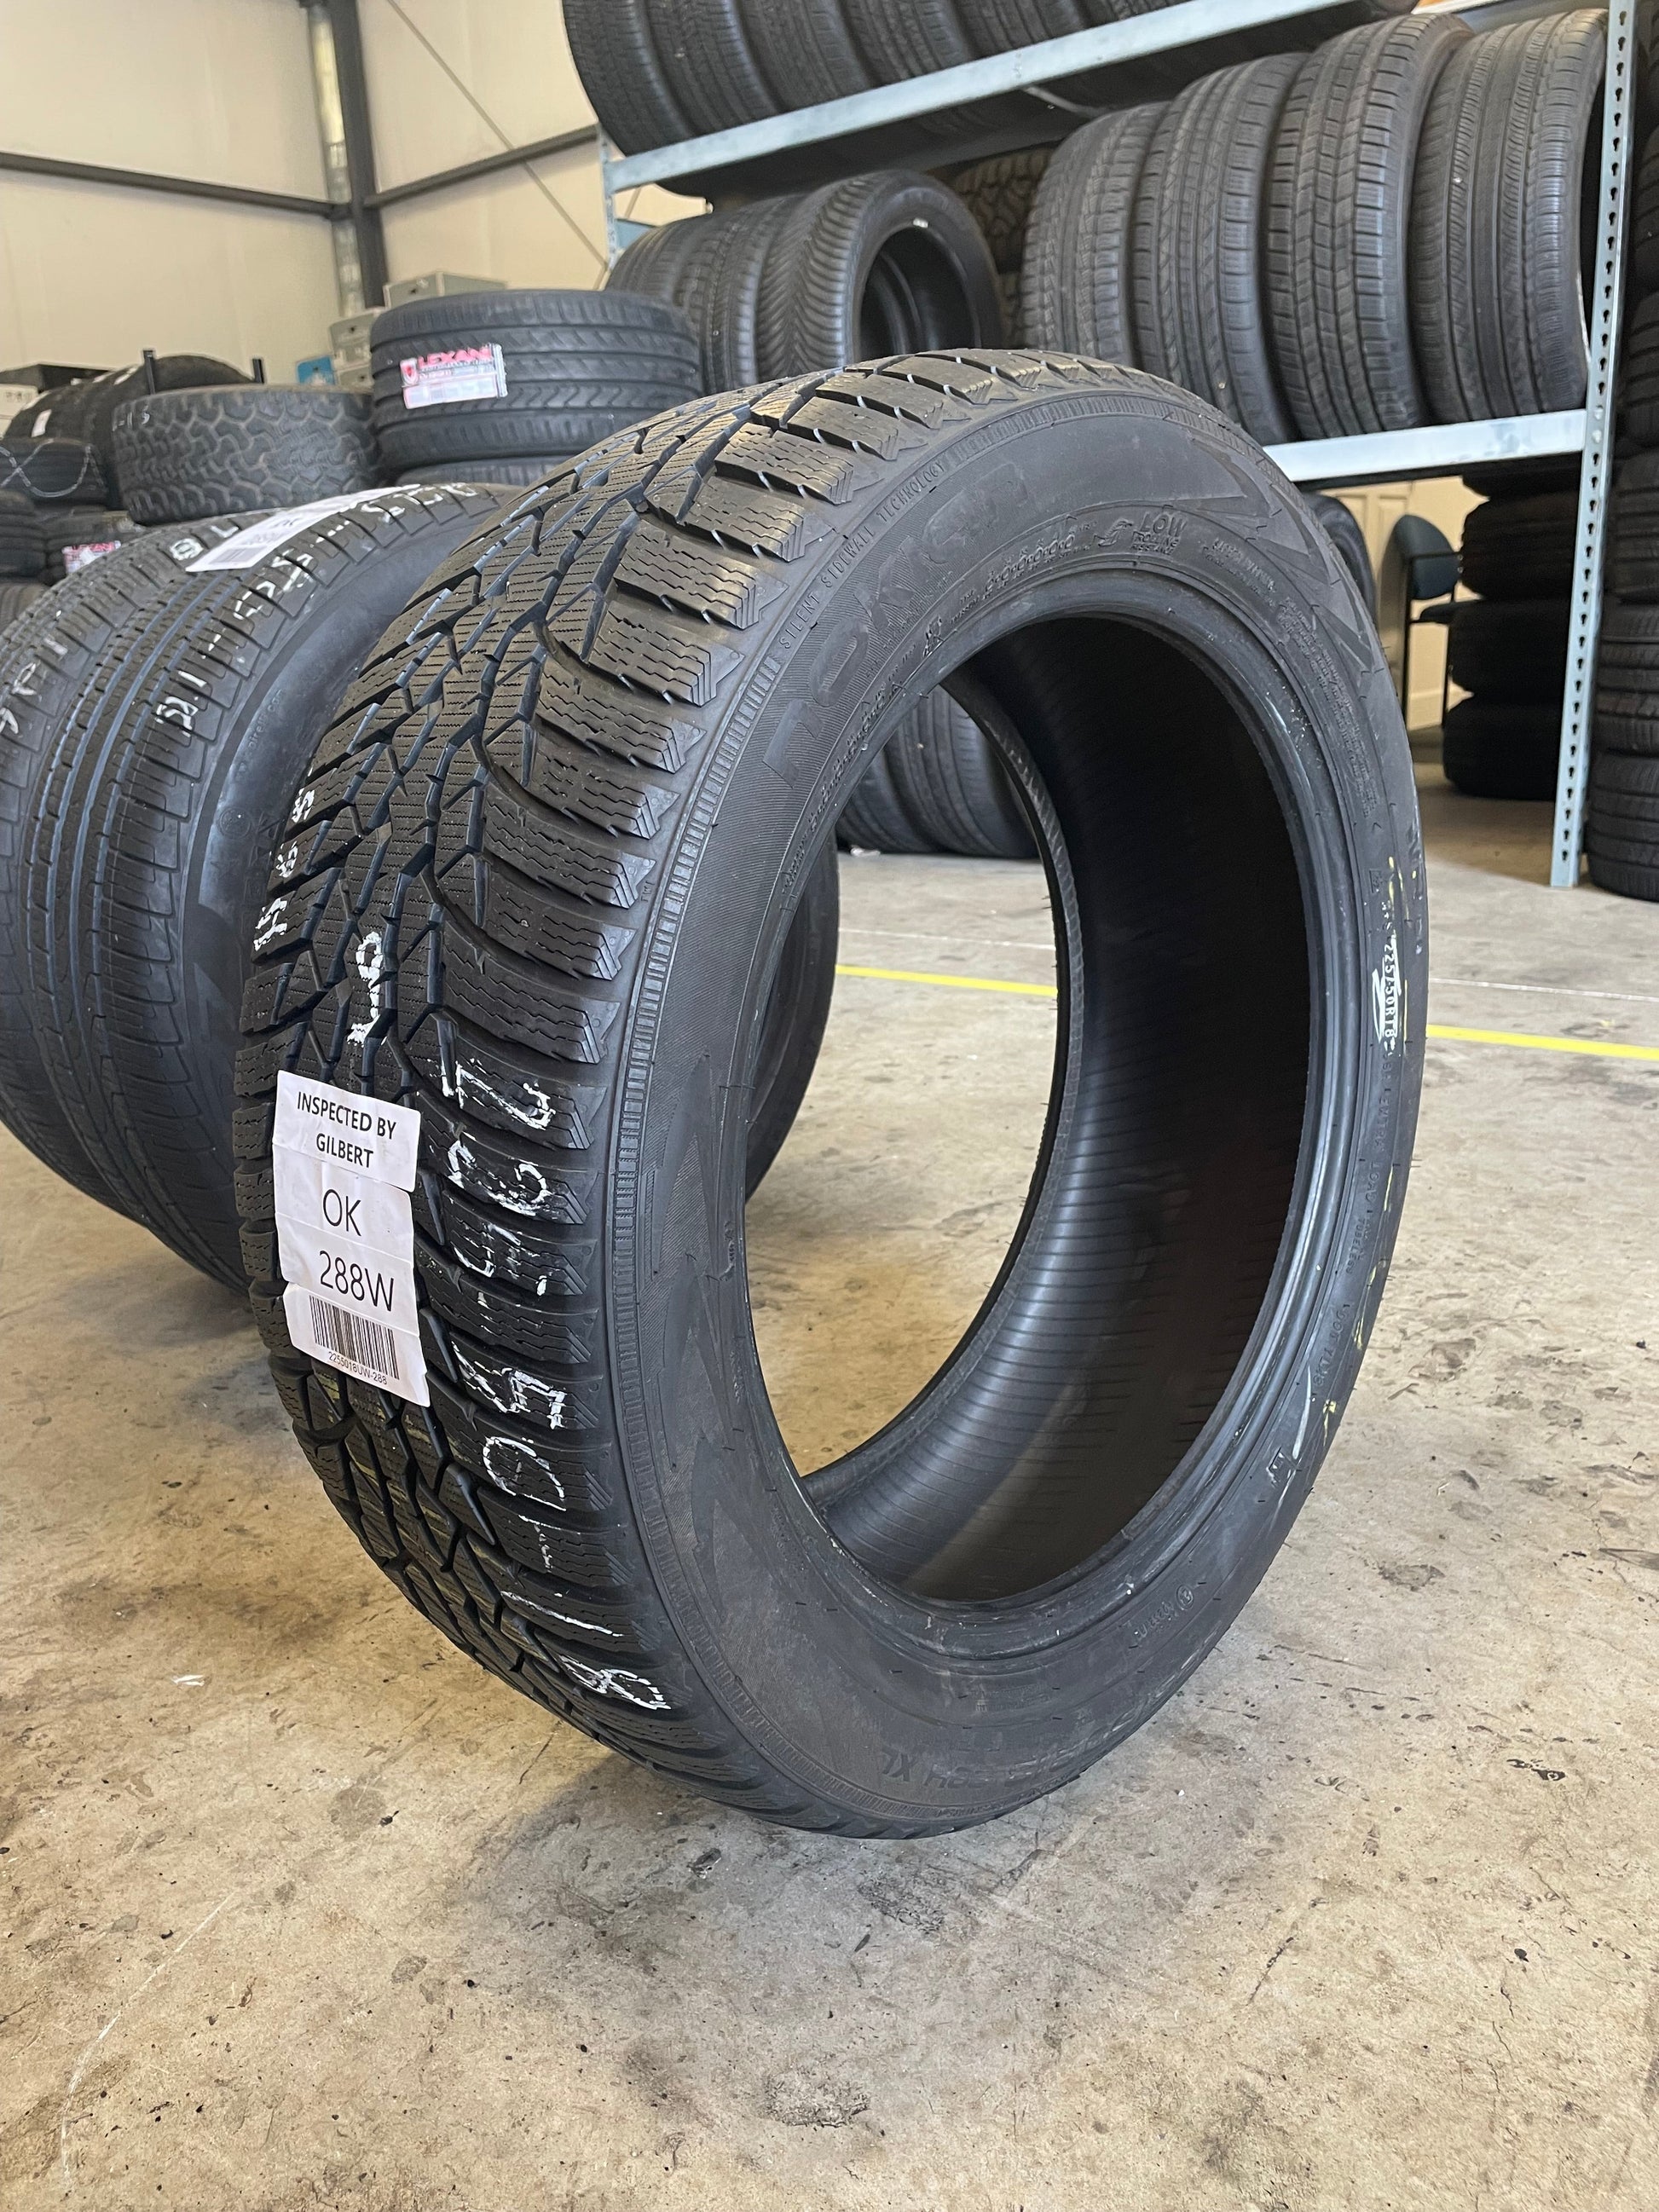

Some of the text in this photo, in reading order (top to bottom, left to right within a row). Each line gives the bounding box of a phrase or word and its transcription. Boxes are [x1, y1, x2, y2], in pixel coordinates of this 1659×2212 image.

[1139, 511, 1188, 535] LOW
[779, 594, 821, 651] SILENT
[821, 524, 877, 589] SIDEWALL
[875, 460, 947, 525] TECHNOLOGY
[297, 1090, 397, 1141] INSPECTED BY
[315, 1133, 374, 1169] GILBERT
[322, 1188, 362, 1237] OK
[319, 1250, 395, 1313] 288W
[327, 1350, 389, 1386] 2255018UW-288
